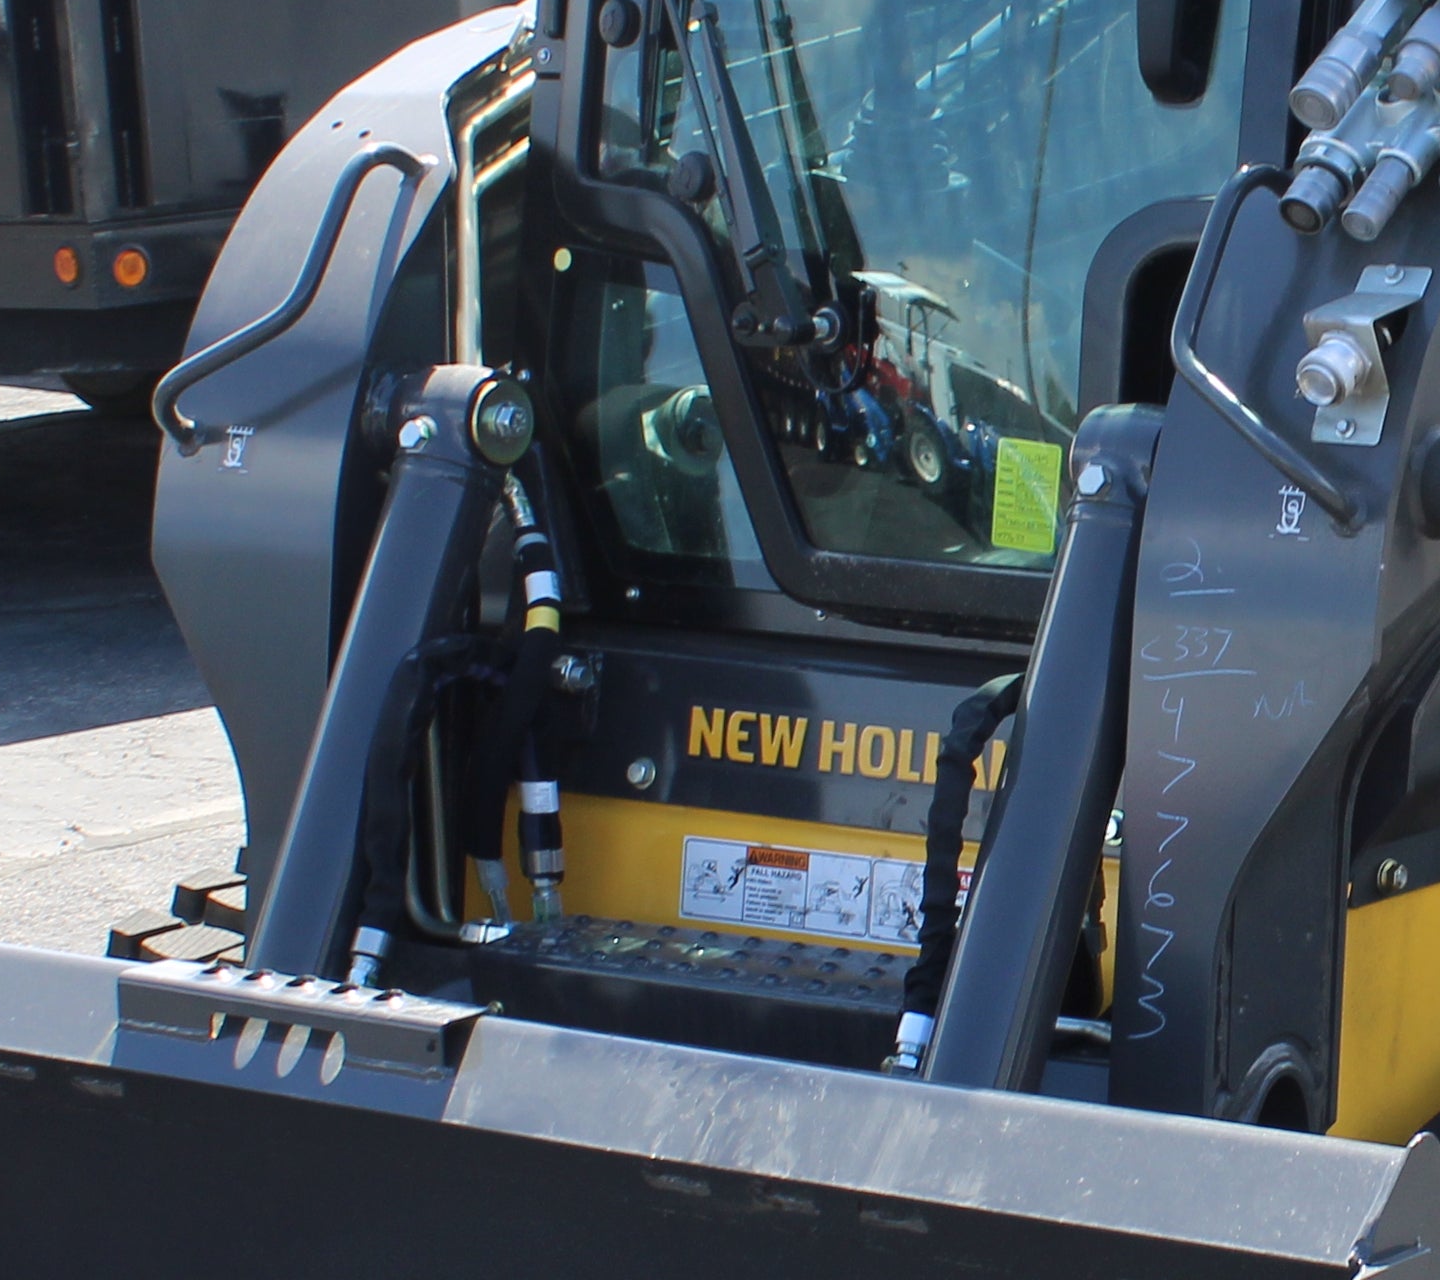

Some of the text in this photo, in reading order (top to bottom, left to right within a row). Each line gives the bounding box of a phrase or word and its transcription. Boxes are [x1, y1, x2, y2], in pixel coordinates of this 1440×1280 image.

[687, 705, 1008, 792] NEW HOLL
[758, 851, 807, 869] WARNING
